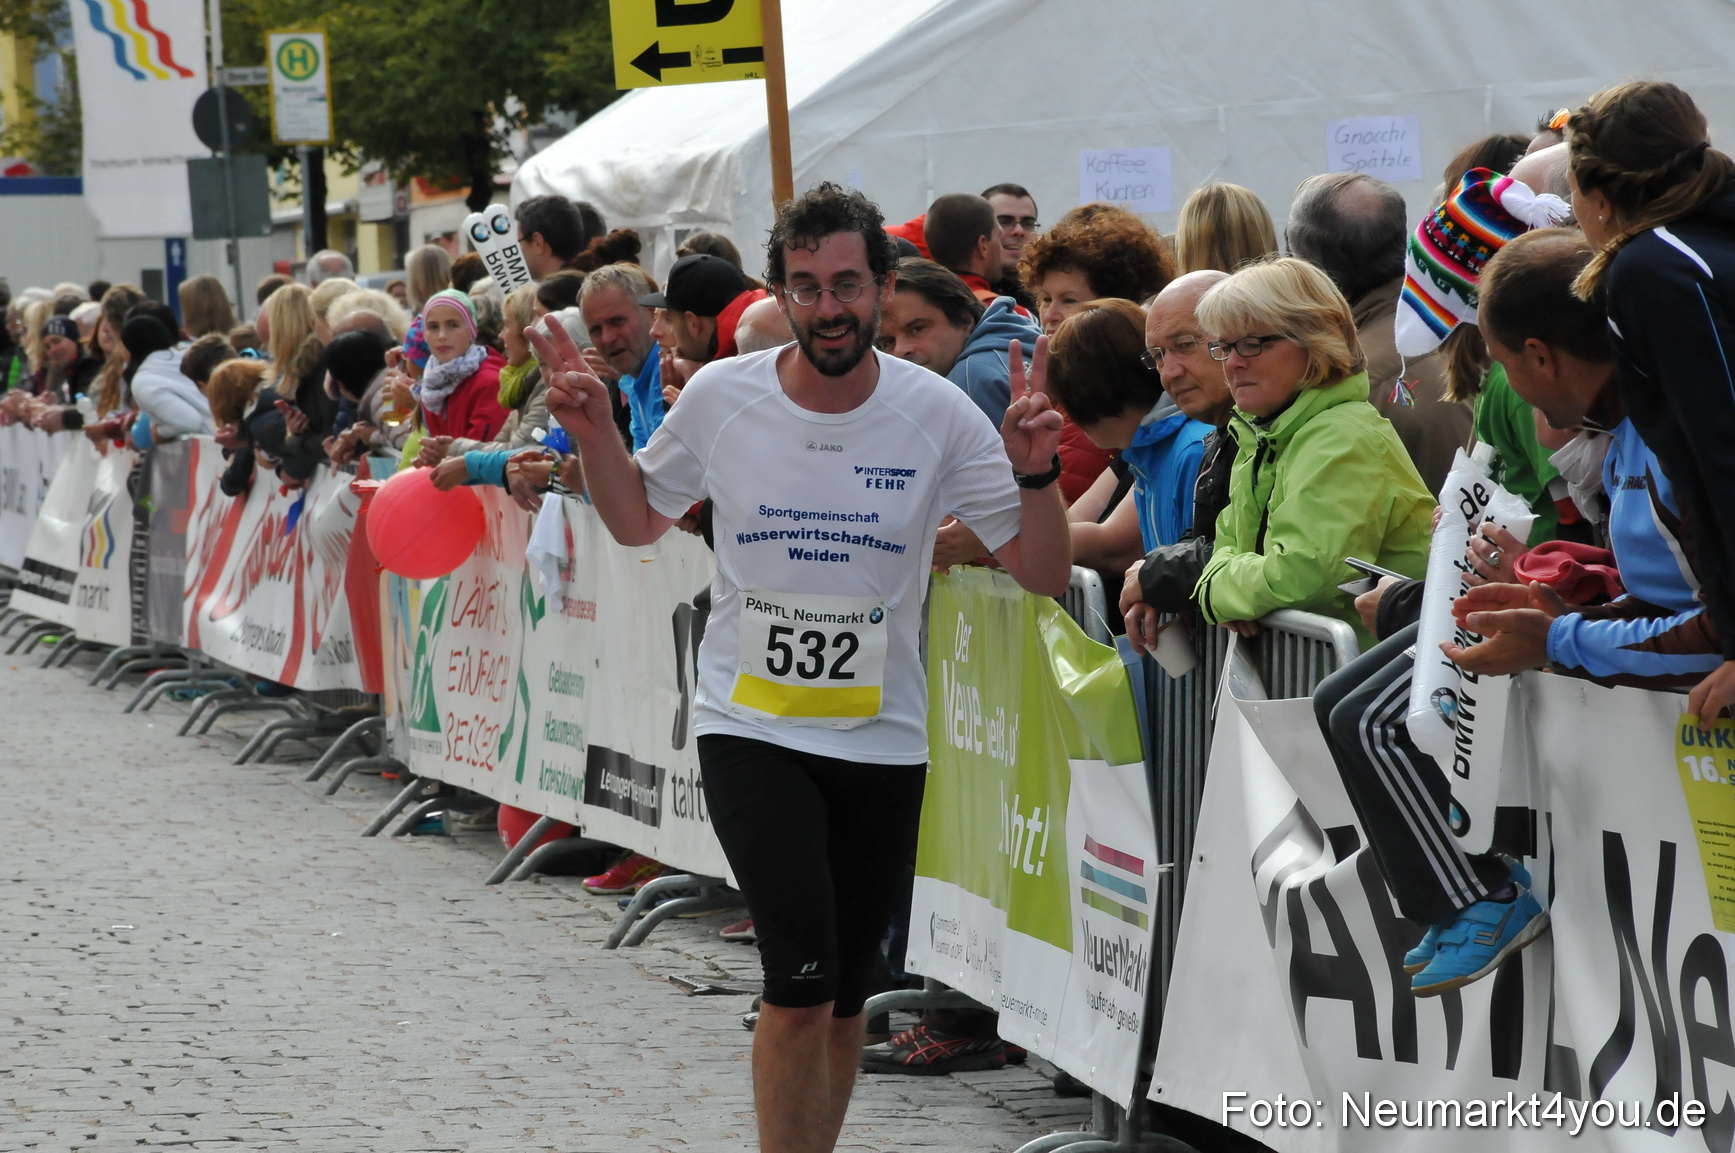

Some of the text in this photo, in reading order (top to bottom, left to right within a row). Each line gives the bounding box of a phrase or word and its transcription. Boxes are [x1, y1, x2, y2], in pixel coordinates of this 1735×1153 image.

[1335, 121, 1406, 145] Gnocchi
[1341, 148, 1412, 173] Spätzle
[819, 443, 843, 452] JAKO
[864, 467, 917, 478] INTERSPORT
[865, 478, 905, 490] FEHR
[759, 504, 880, 523] Sportgemeinschaft
[736, 527, 906, 555] Wasserwirtschaftsamt
[788, 548, 850, 562] Weiden
[746, 597, 865, 625] PARTL Neumarkt
[955, 611, 972, 663] Der
[766, 625, 859, 680] 532
[942, 659, 983, 756] Neue
[1681, 724, 1735, 749] URK
[1682, 754, 1728, 785] 16.
